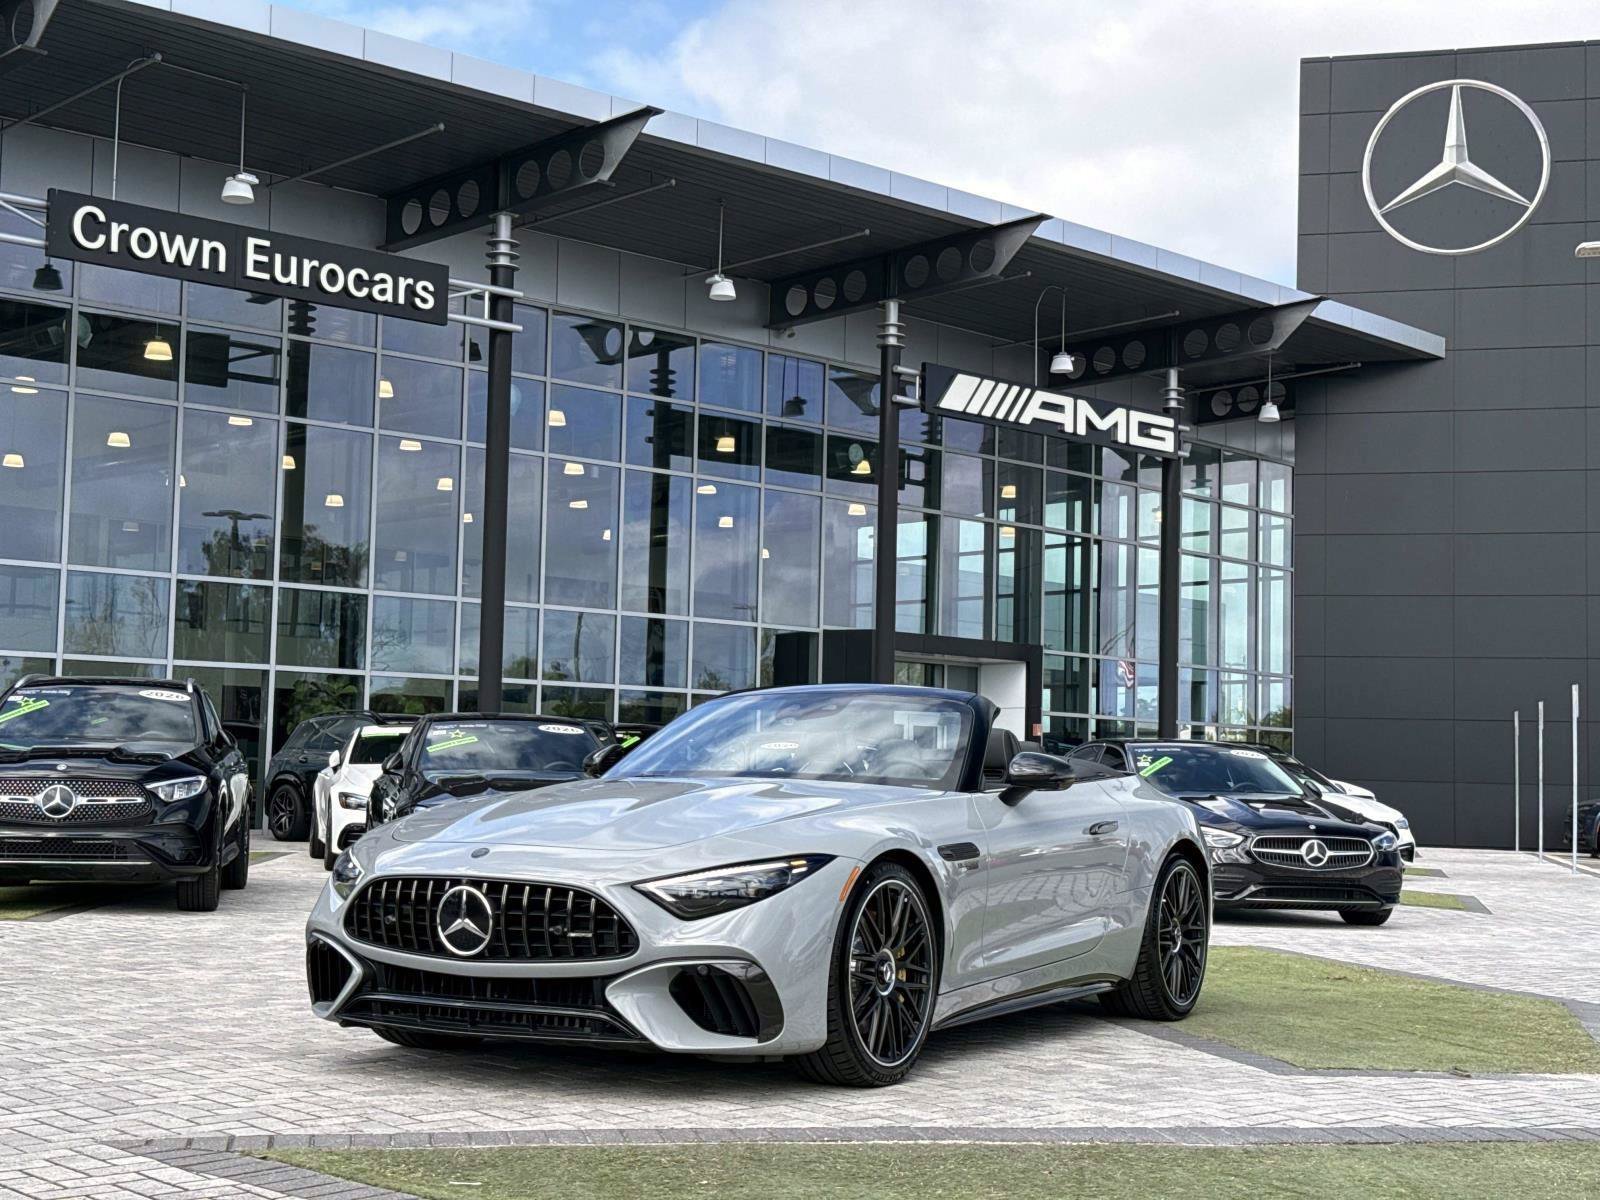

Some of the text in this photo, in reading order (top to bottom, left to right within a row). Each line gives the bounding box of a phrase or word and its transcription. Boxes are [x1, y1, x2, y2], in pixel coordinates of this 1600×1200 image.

[72, 205, 435, 310] Crown Eurocars
[1018, 390, 1175, 453] AMG
